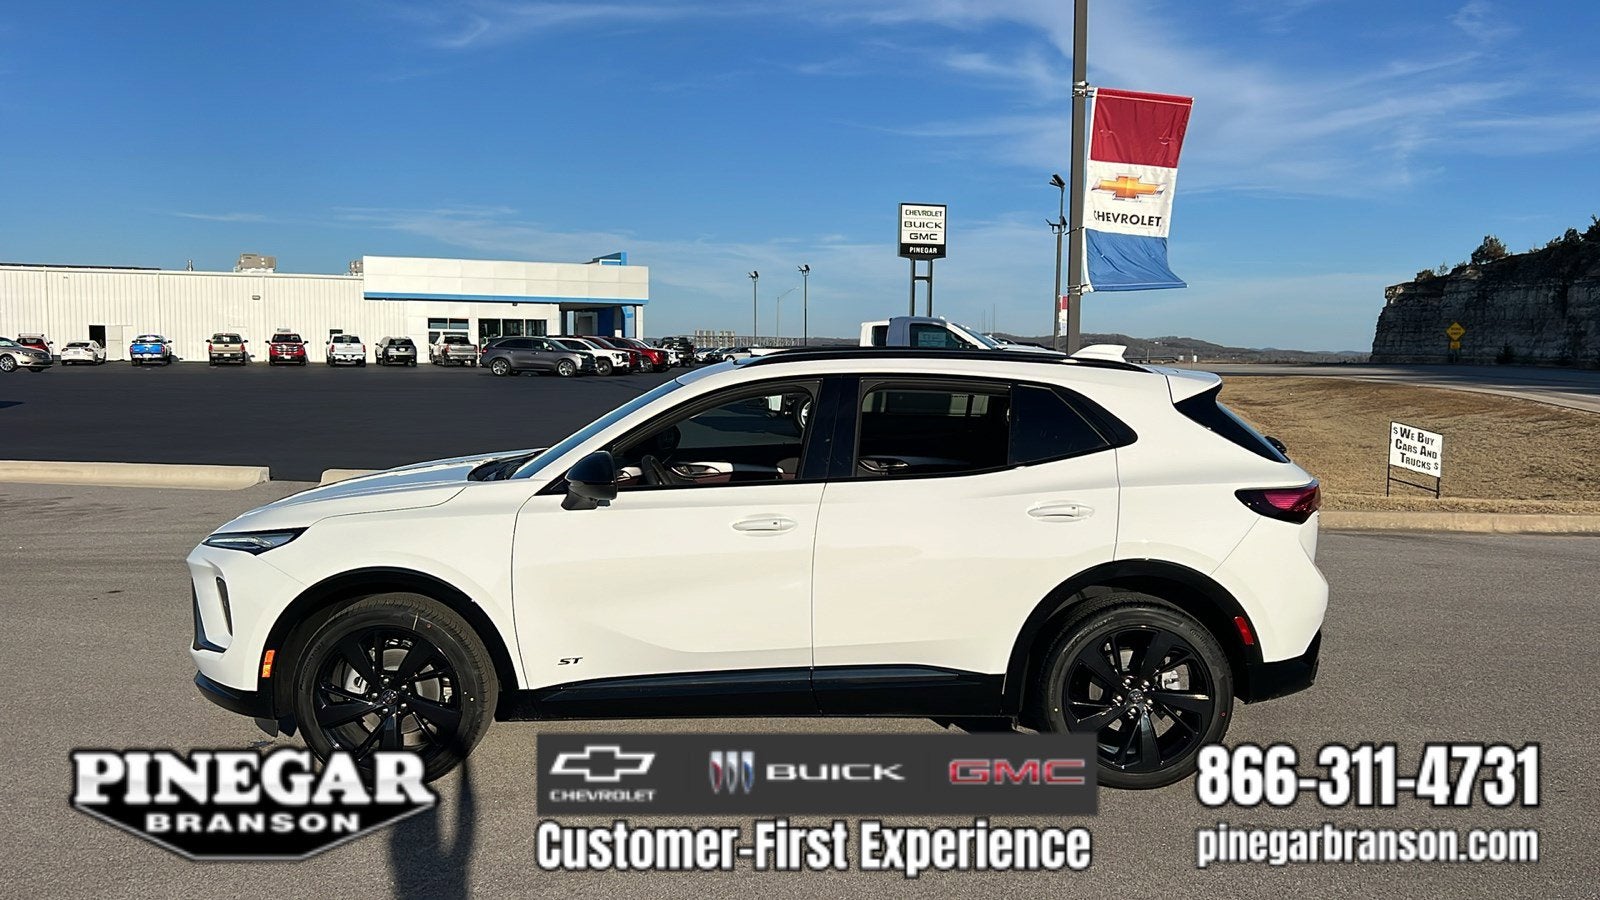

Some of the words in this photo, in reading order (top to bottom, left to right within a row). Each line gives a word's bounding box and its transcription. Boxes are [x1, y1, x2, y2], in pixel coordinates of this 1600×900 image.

[905, 209, 943, 217] CHEVROLET
[904, 221, 943, 229] BUICK
[909, 246, 938, 254] PINEGAR
[557, 656, 584, 666] ST
